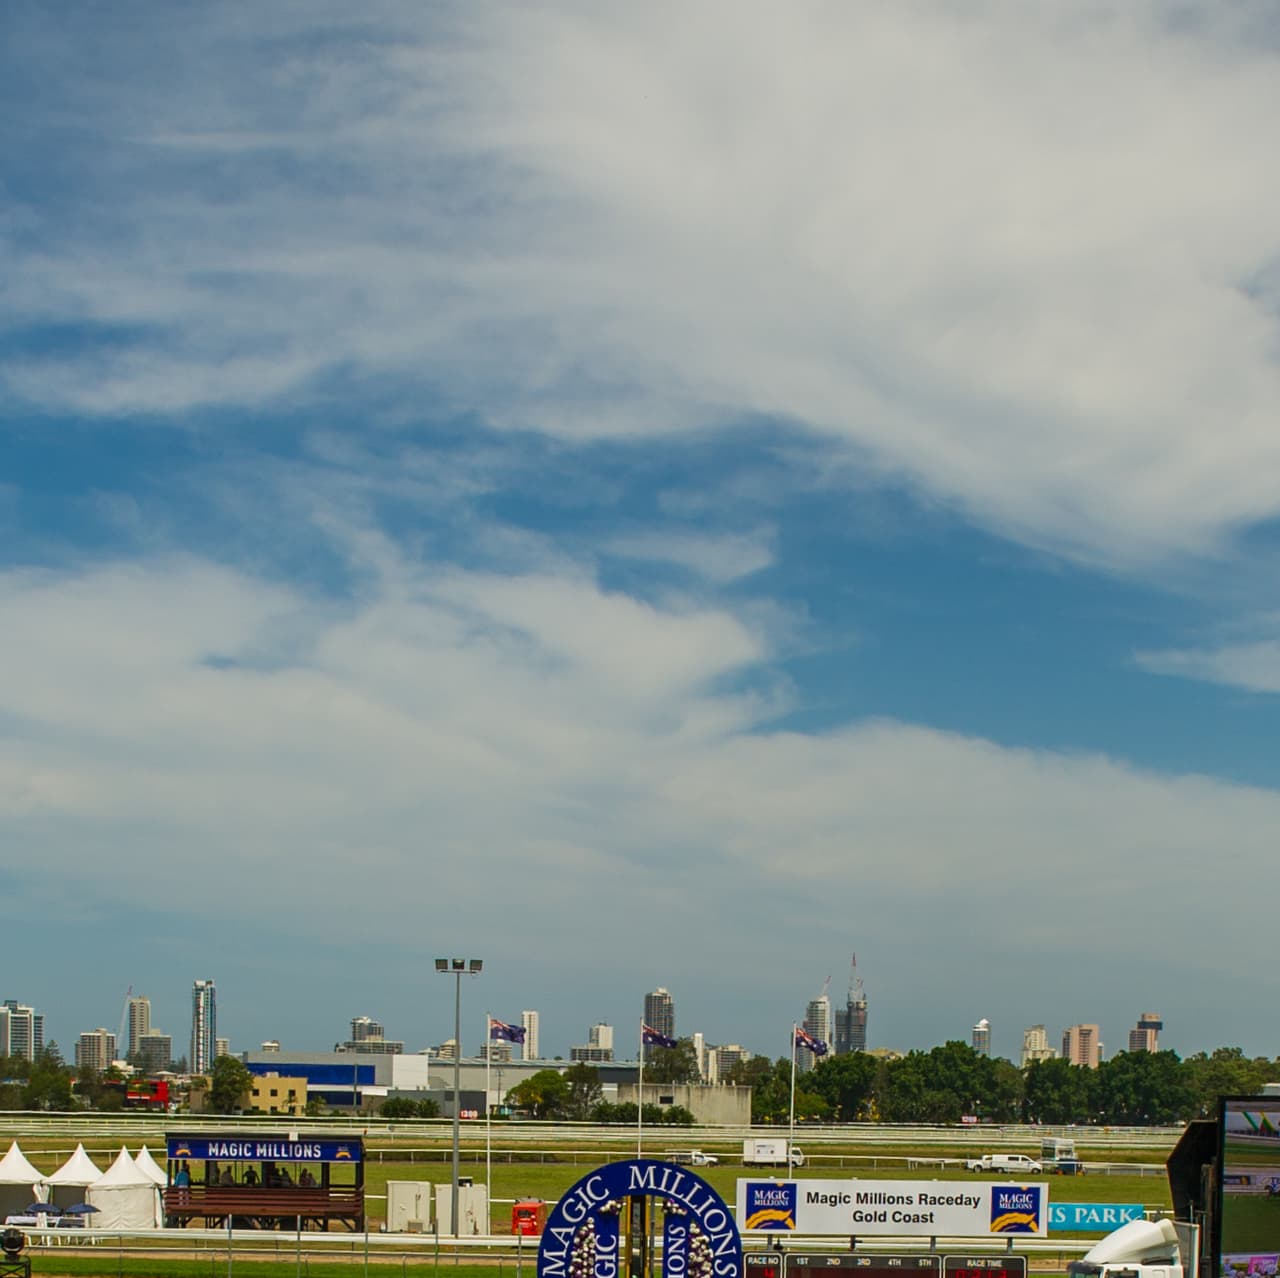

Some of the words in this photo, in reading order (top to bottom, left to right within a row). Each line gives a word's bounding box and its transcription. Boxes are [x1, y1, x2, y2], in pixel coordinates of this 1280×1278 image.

[208, 1142, 252, 1157] MAGIC
[257, 1143, 321, 1158] MILLIONS
[754, 1190, 790, 1201] MAGIC
[806, 1191, 851, 1207] Magic
[856, 1192, 913, 1205] Millions
[918, 1193, 981, 1209] Raceday
[999, 1193, 1033, 1203] MAGIC
[754, 1199, 790, 1207] MILLIONS
[999, 1201, 1034, 1210] MILLIONS
[542, 1175, 609, 1277] MAGIC
[629, 1165, 737, 1277] MILLIONS
[853, 1210, 887, 1223] Gold
[892, 1211, 934, 1224] Coast
[1075, 1208, 1135, 1224] PARK
[748, 1257, 767, 1265] RACE
[768, 1257, 780, 1265] NO
[827, 1258, 841, 1266] 2ND
[857, 1258, 871, 1266] 3RD
[888, 1259, 902, 1267] 4TH
[919, 1259, 932, 1267] 5TH
